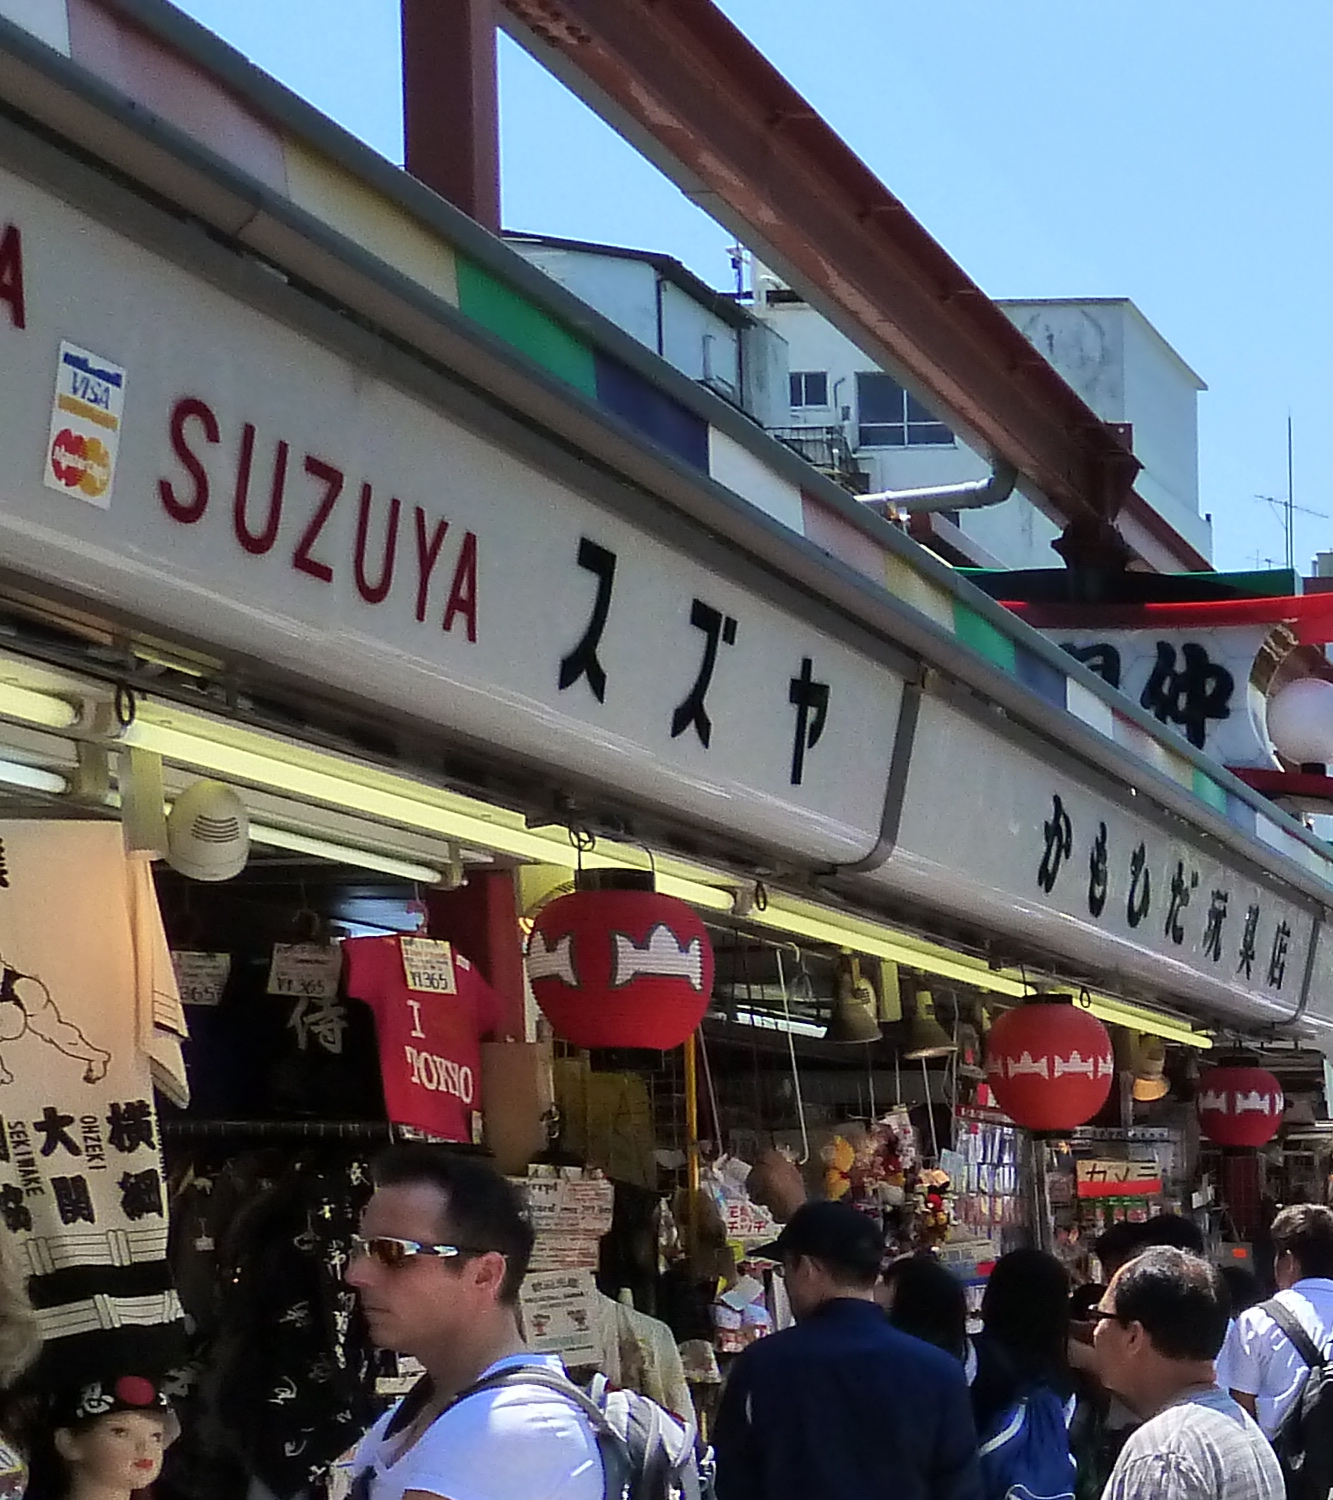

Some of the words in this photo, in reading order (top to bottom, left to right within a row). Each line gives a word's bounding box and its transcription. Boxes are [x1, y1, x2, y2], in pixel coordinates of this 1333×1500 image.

[71, 370, 112, 410] VISA
[158, 397, 480, 645] SUZUYA
[557, 536, 830, 787] スズヤ
[406, 999, 426, 1039] I
[405, 1045, 473, 1104] TOKYO
[7, 1121, 46, 1198] SEKIWAKE
[80, 1115, 107, 1170] OHZEKI
